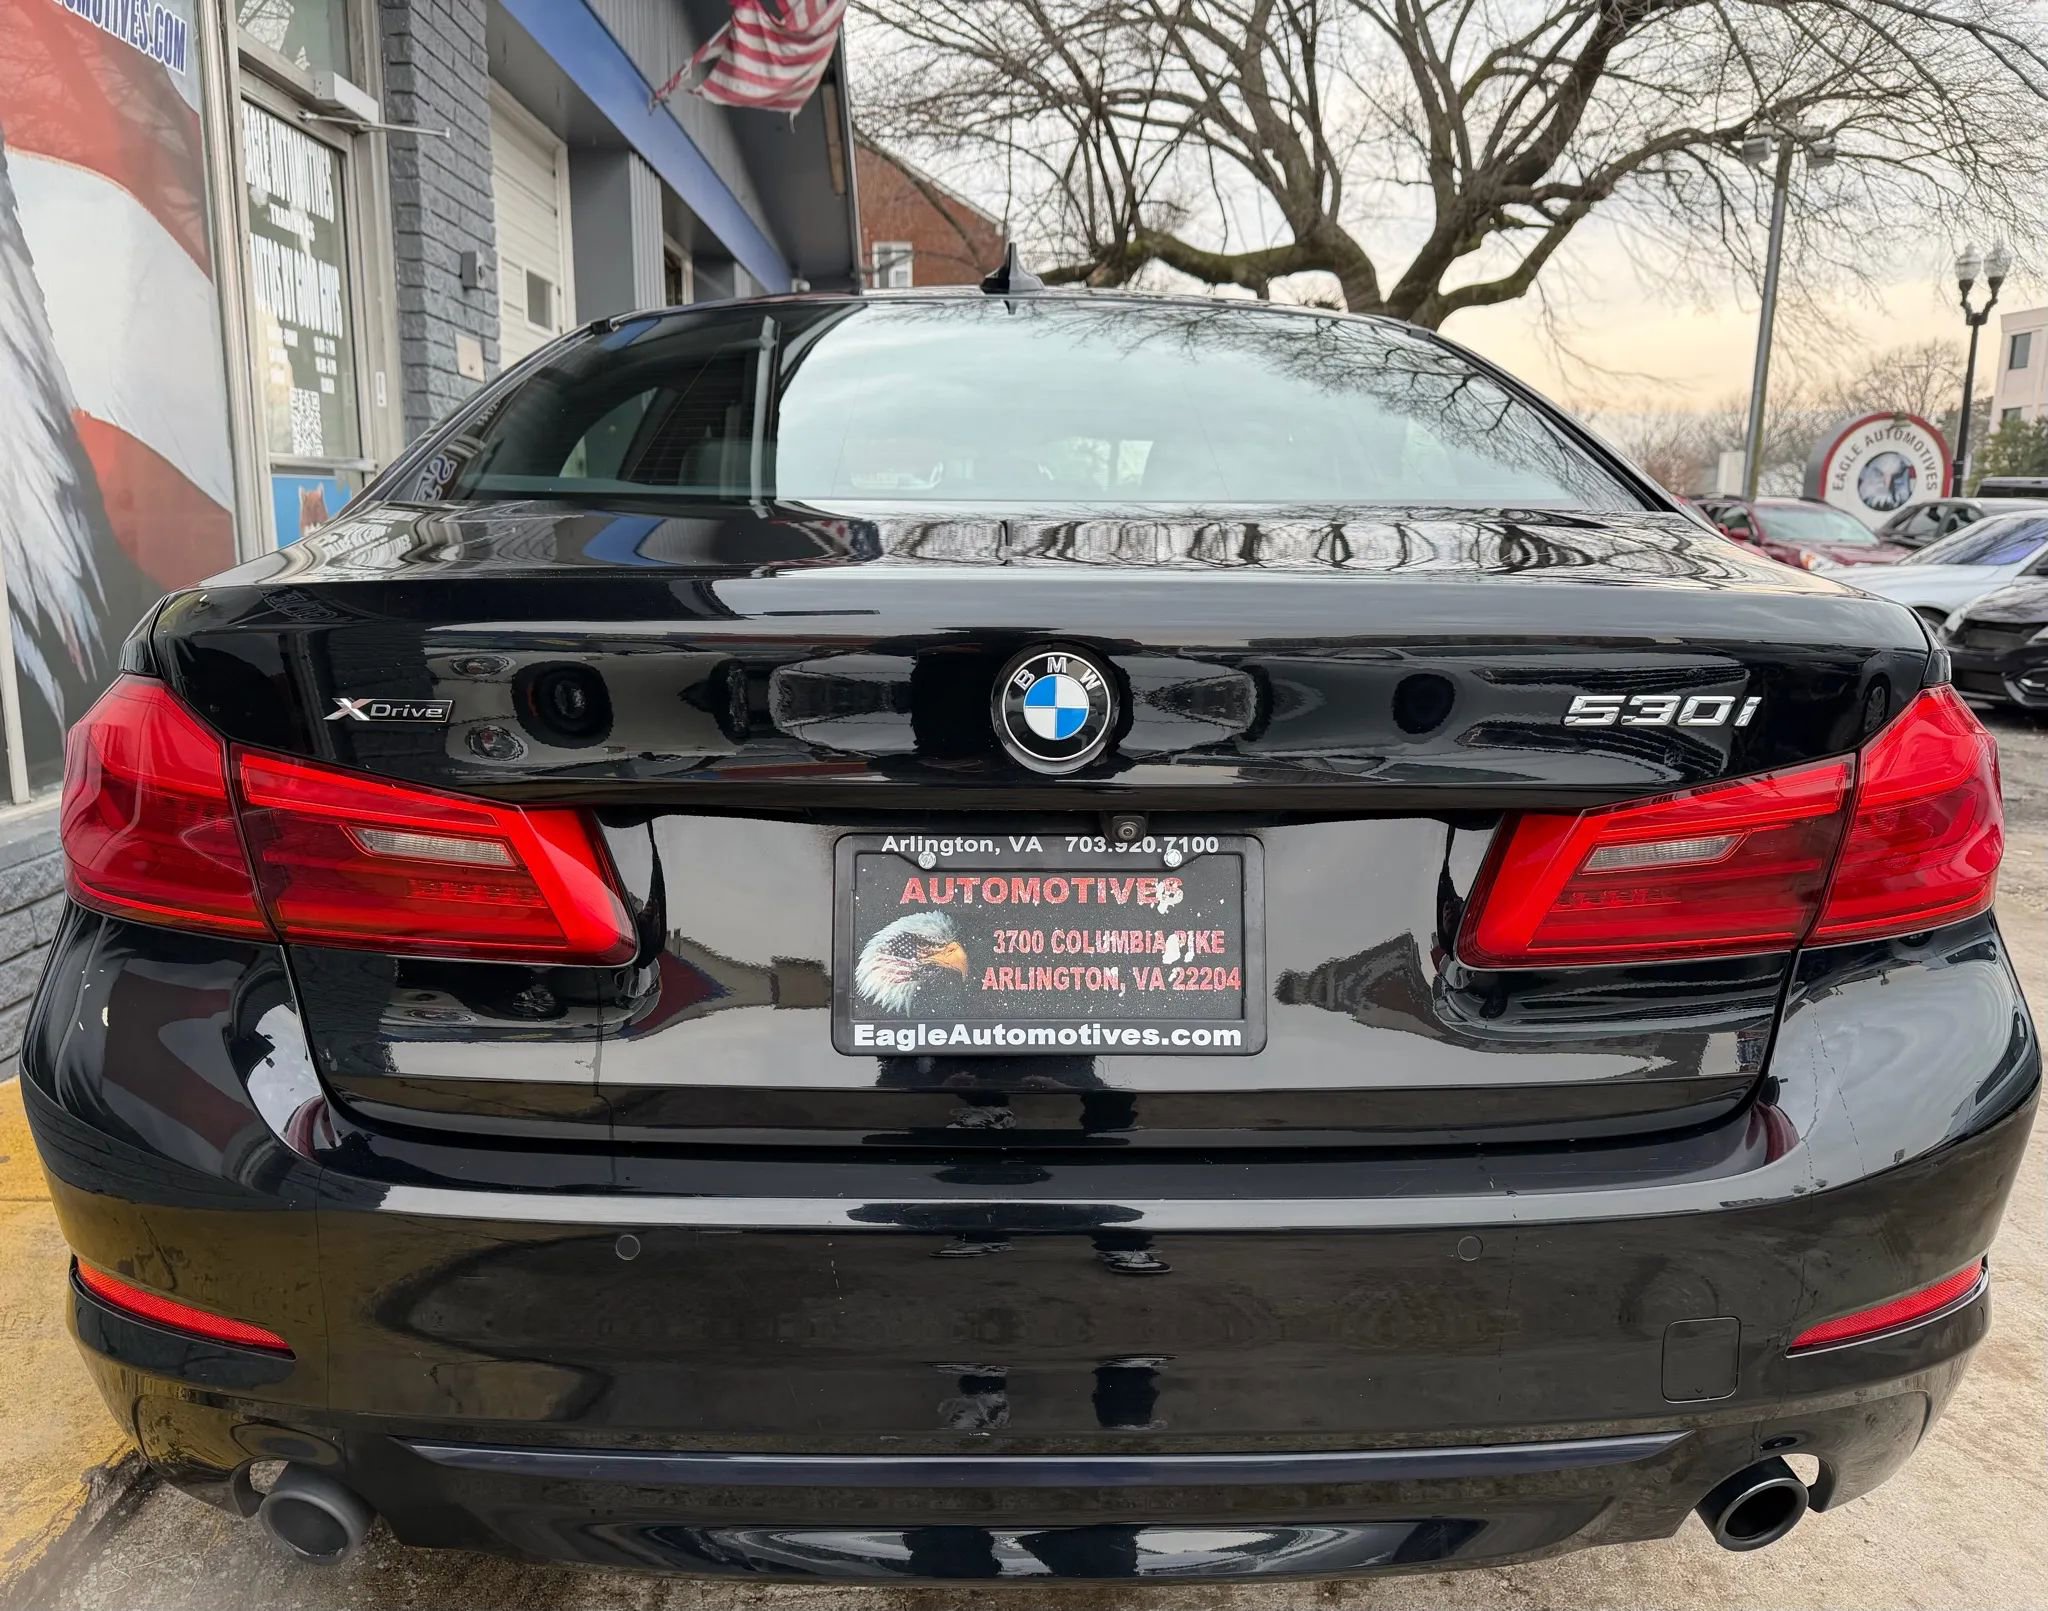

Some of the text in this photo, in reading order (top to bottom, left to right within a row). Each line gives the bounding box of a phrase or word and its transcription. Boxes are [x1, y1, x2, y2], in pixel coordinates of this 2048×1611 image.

[1832, 428, 1938, 491] EAGLE AUTOMOTIVES
[1013, 656, 1102, 691] BMW
[1563, 695, 1763, 727] 530i
[881, 835, 1219, 856] Arlington, VA 703.920.7100
[900, 876, 1184, 905] AUTOMOTIVES
[993, 929, 1044, 954] 3700
[1051, 929, 1166, 954] COLUMBIA
[982, 966, 1241, 995] ARLINGTON, VA 22204
[854, 1023, 1242, 1051] EagleAutomotives.com
